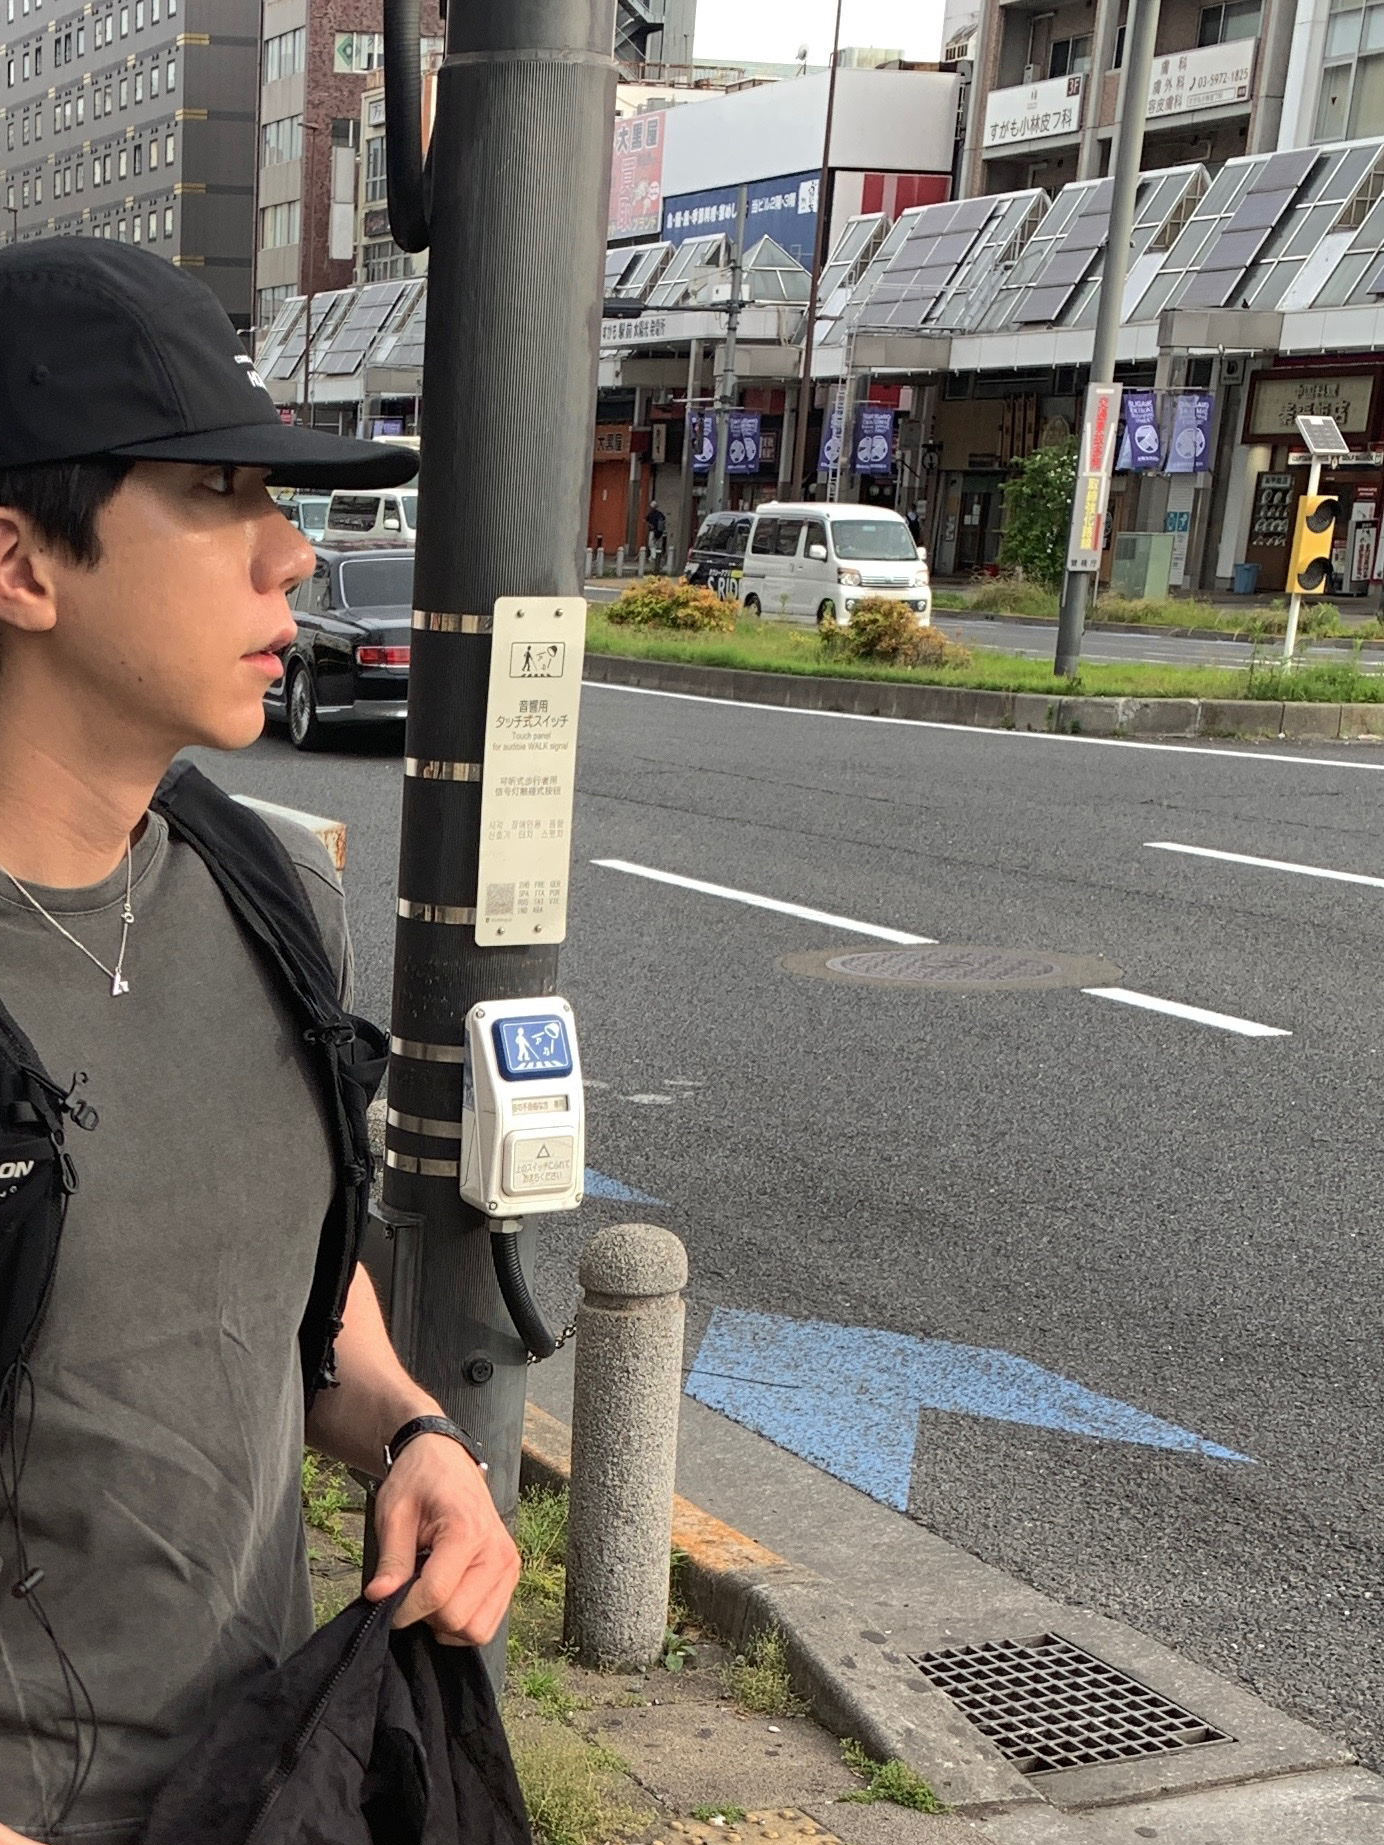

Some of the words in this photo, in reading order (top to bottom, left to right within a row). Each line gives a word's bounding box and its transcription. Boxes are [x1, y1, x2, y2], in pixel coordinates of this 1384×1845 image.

[1068, 78, 1079, 96] 3F
[1148, 94, 1183, 114] 容皮膚科
[990, 108, 1073, 141] すがも小林皮フ科
[518, 699, 548, 714] 音響用
[495, 714, 569, 729] タッチ式スイッチ
[512, 731, 532, 740] Touch
[533, 731, 552, 741] panel
[492, 742, 502, 751] for
[528, 742, 548, 751] WALK
[550, 742, 569, 752] signal
